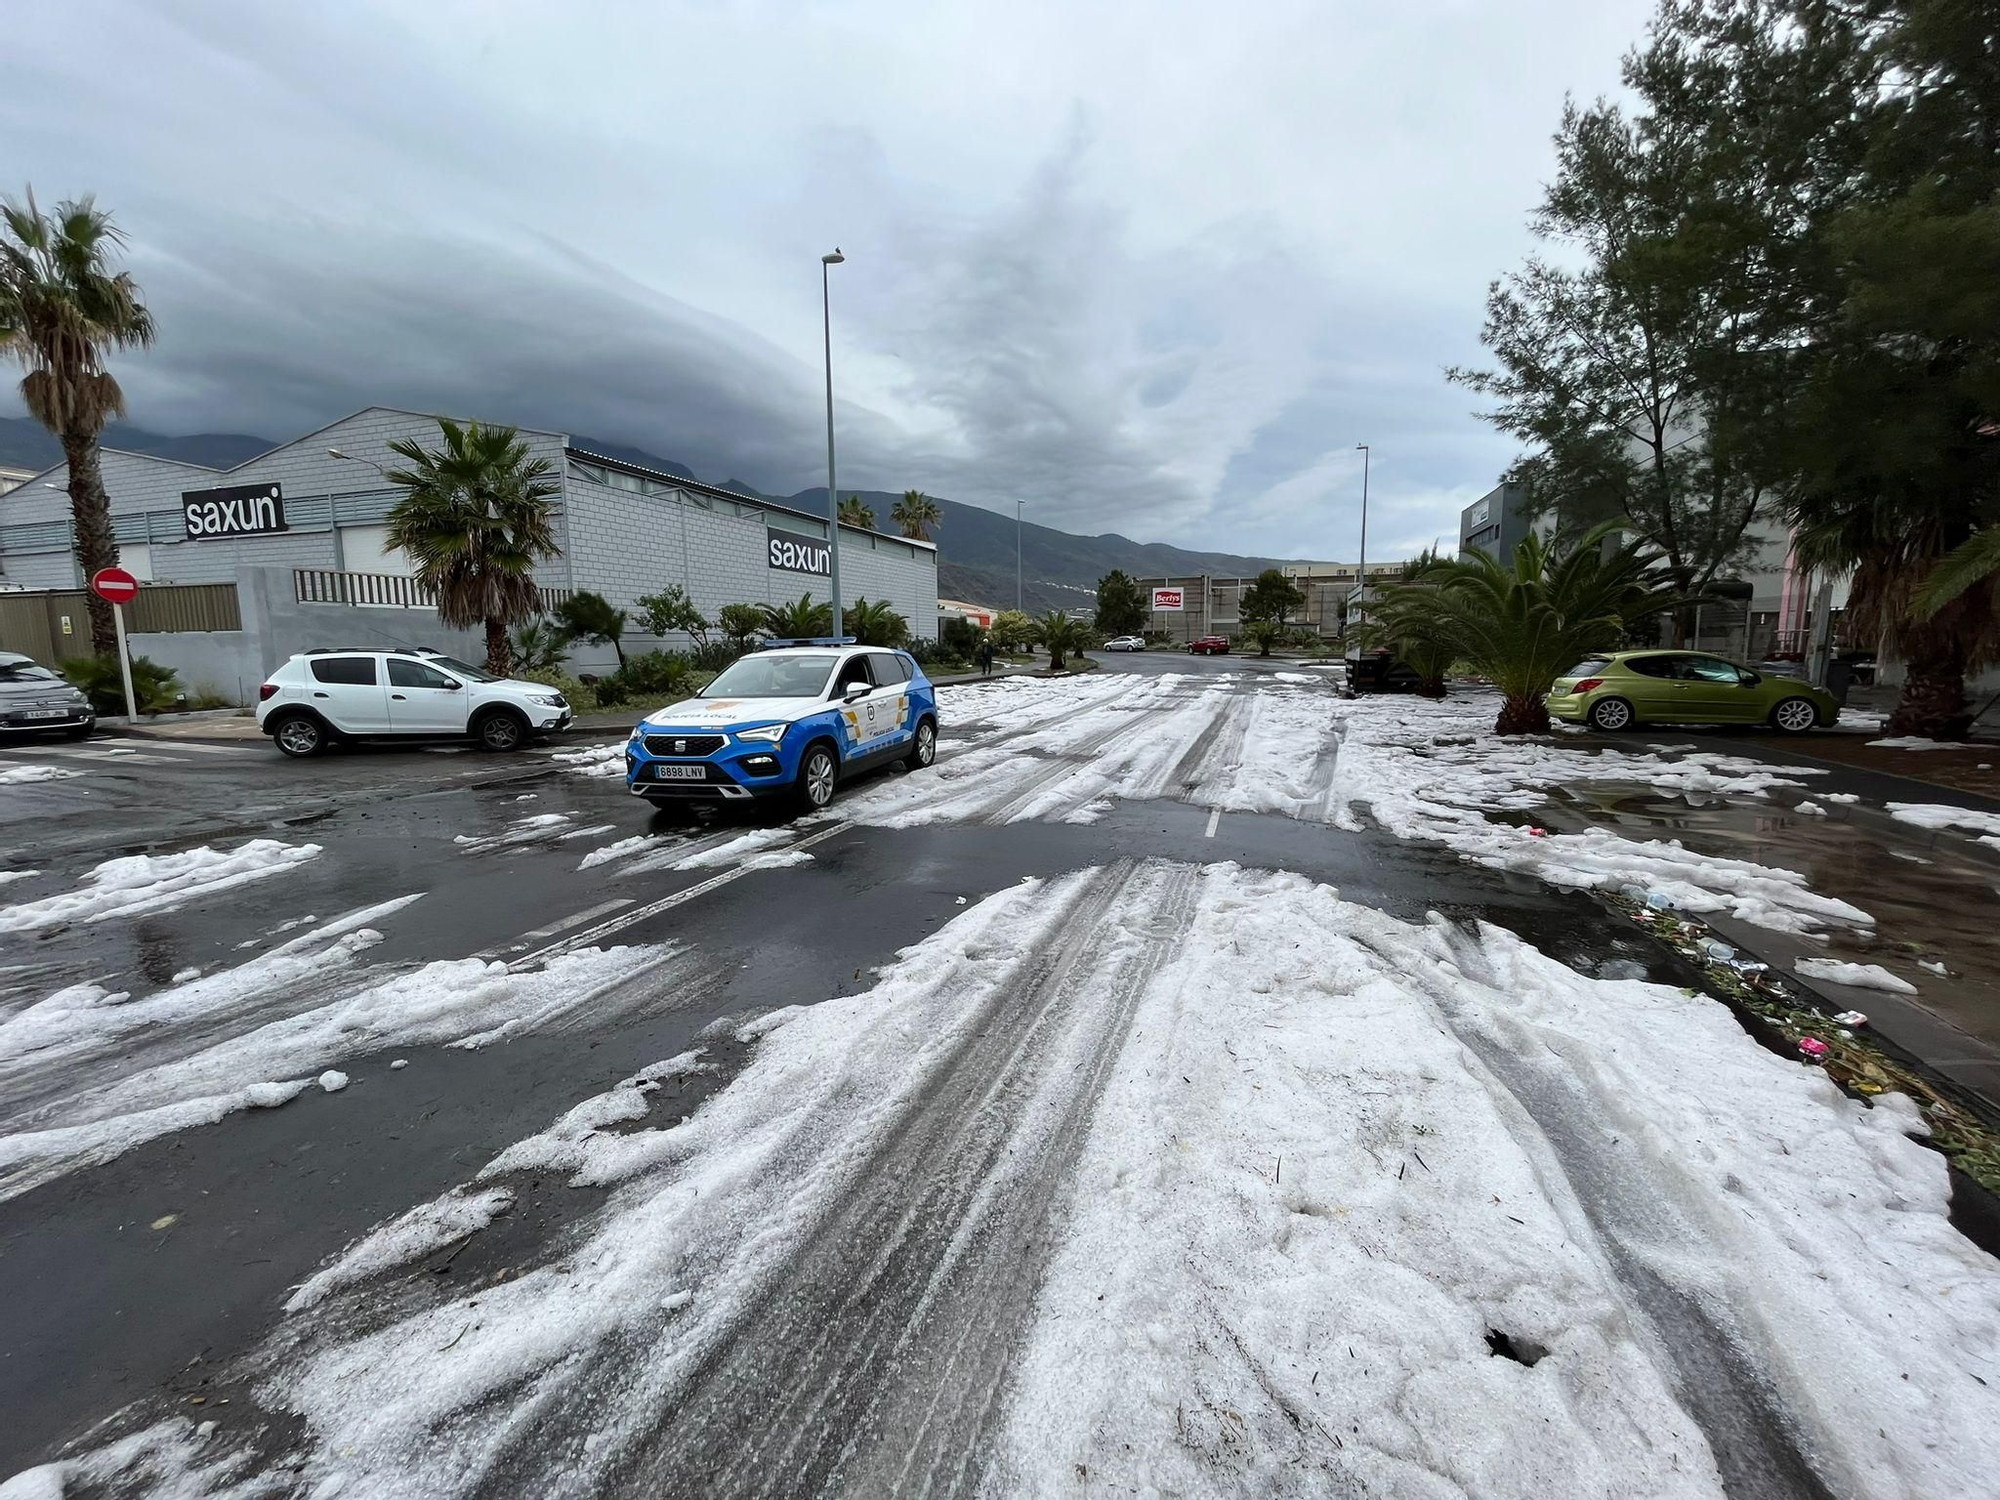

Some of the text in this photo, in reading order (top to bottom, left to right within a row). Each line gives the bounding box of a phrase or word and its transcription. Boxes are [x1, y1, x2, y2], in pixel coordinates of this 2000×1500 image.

[186, 495, 277, 535] saxun
[770, 539, 830, 574] saxun
[660, 767, 703, 777] 6898 LNY
